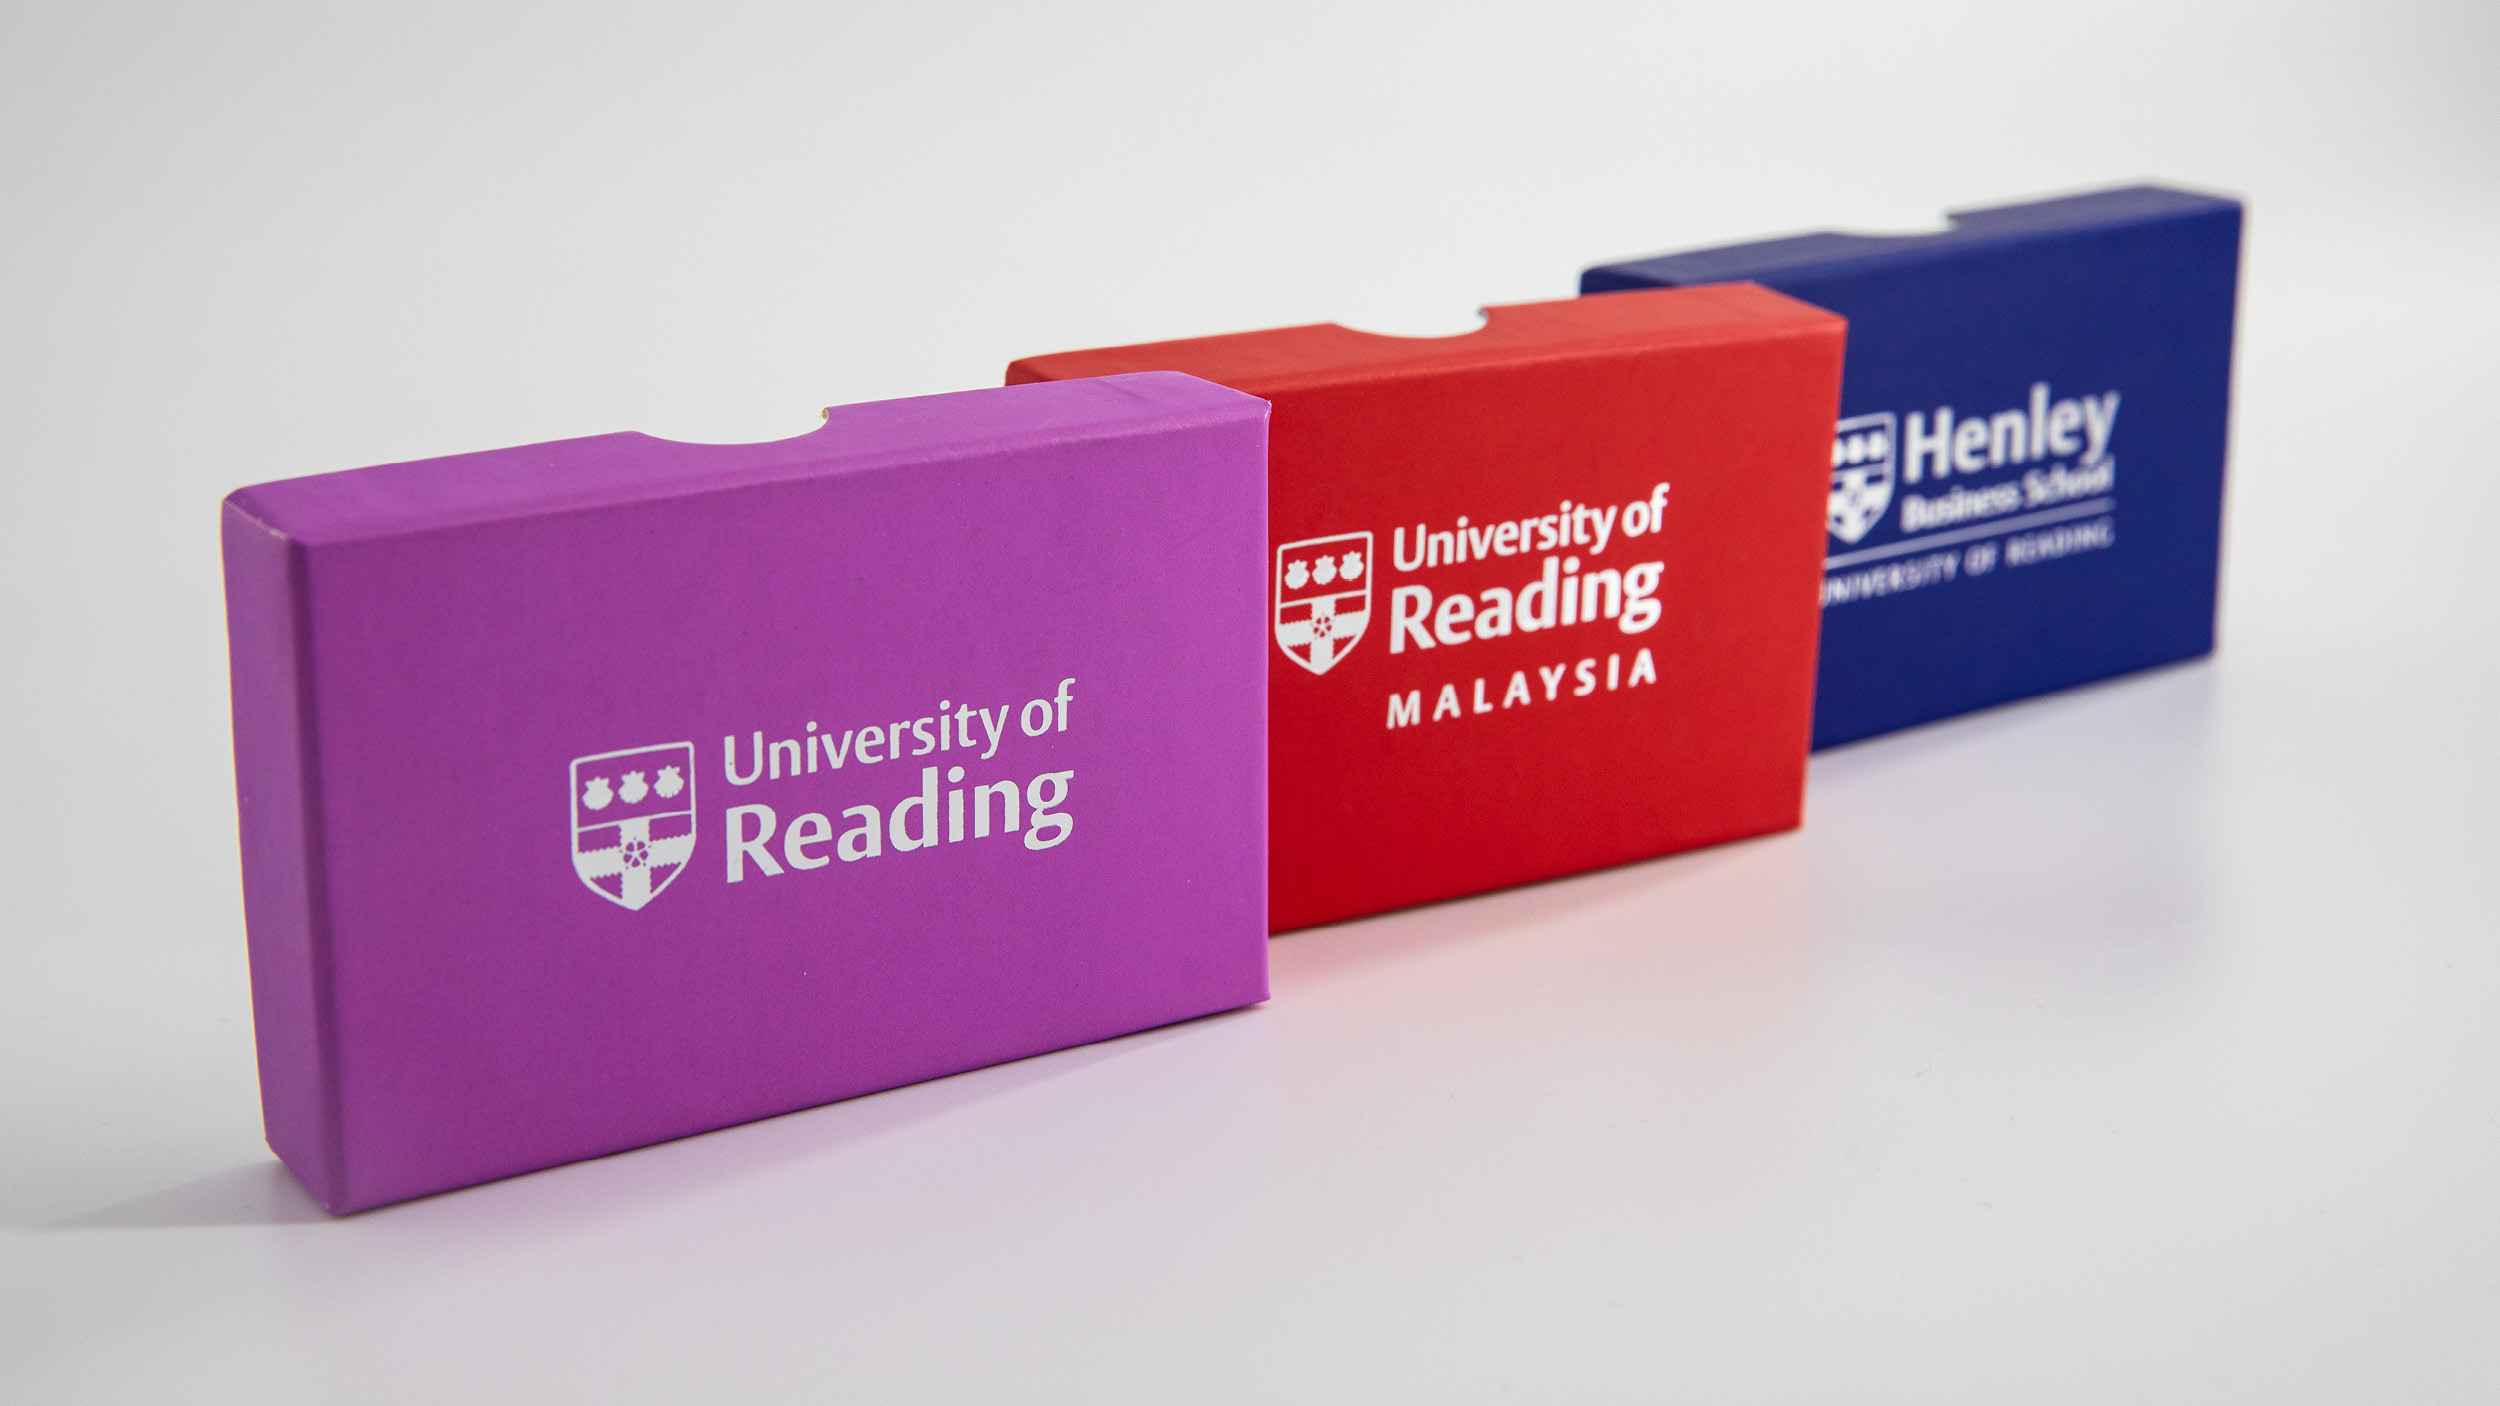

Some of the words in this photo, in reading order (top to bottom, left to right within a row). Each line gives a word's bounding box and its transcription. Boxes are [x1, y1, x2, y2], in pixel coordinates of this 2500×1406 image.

[1902, 382, 2121, 484] Henley
[1393, 500, 1618, 572] University
[1621, 482, 1671, 537] of
[1901, 485, 2021, 533] Business
[2022, 456, 2115, 508] School
[1963, 542, 1998, 576] OF
[2005, 518, 2115, 567] READING
[1389, 555, 1665, 655] Reading
[724, 700, 1009, 785] University
[1020, 678, 1076, 737] of
[1386, 648, 1657, 730] MALAYSIA
[726, 766, 1075, 883] Reading
